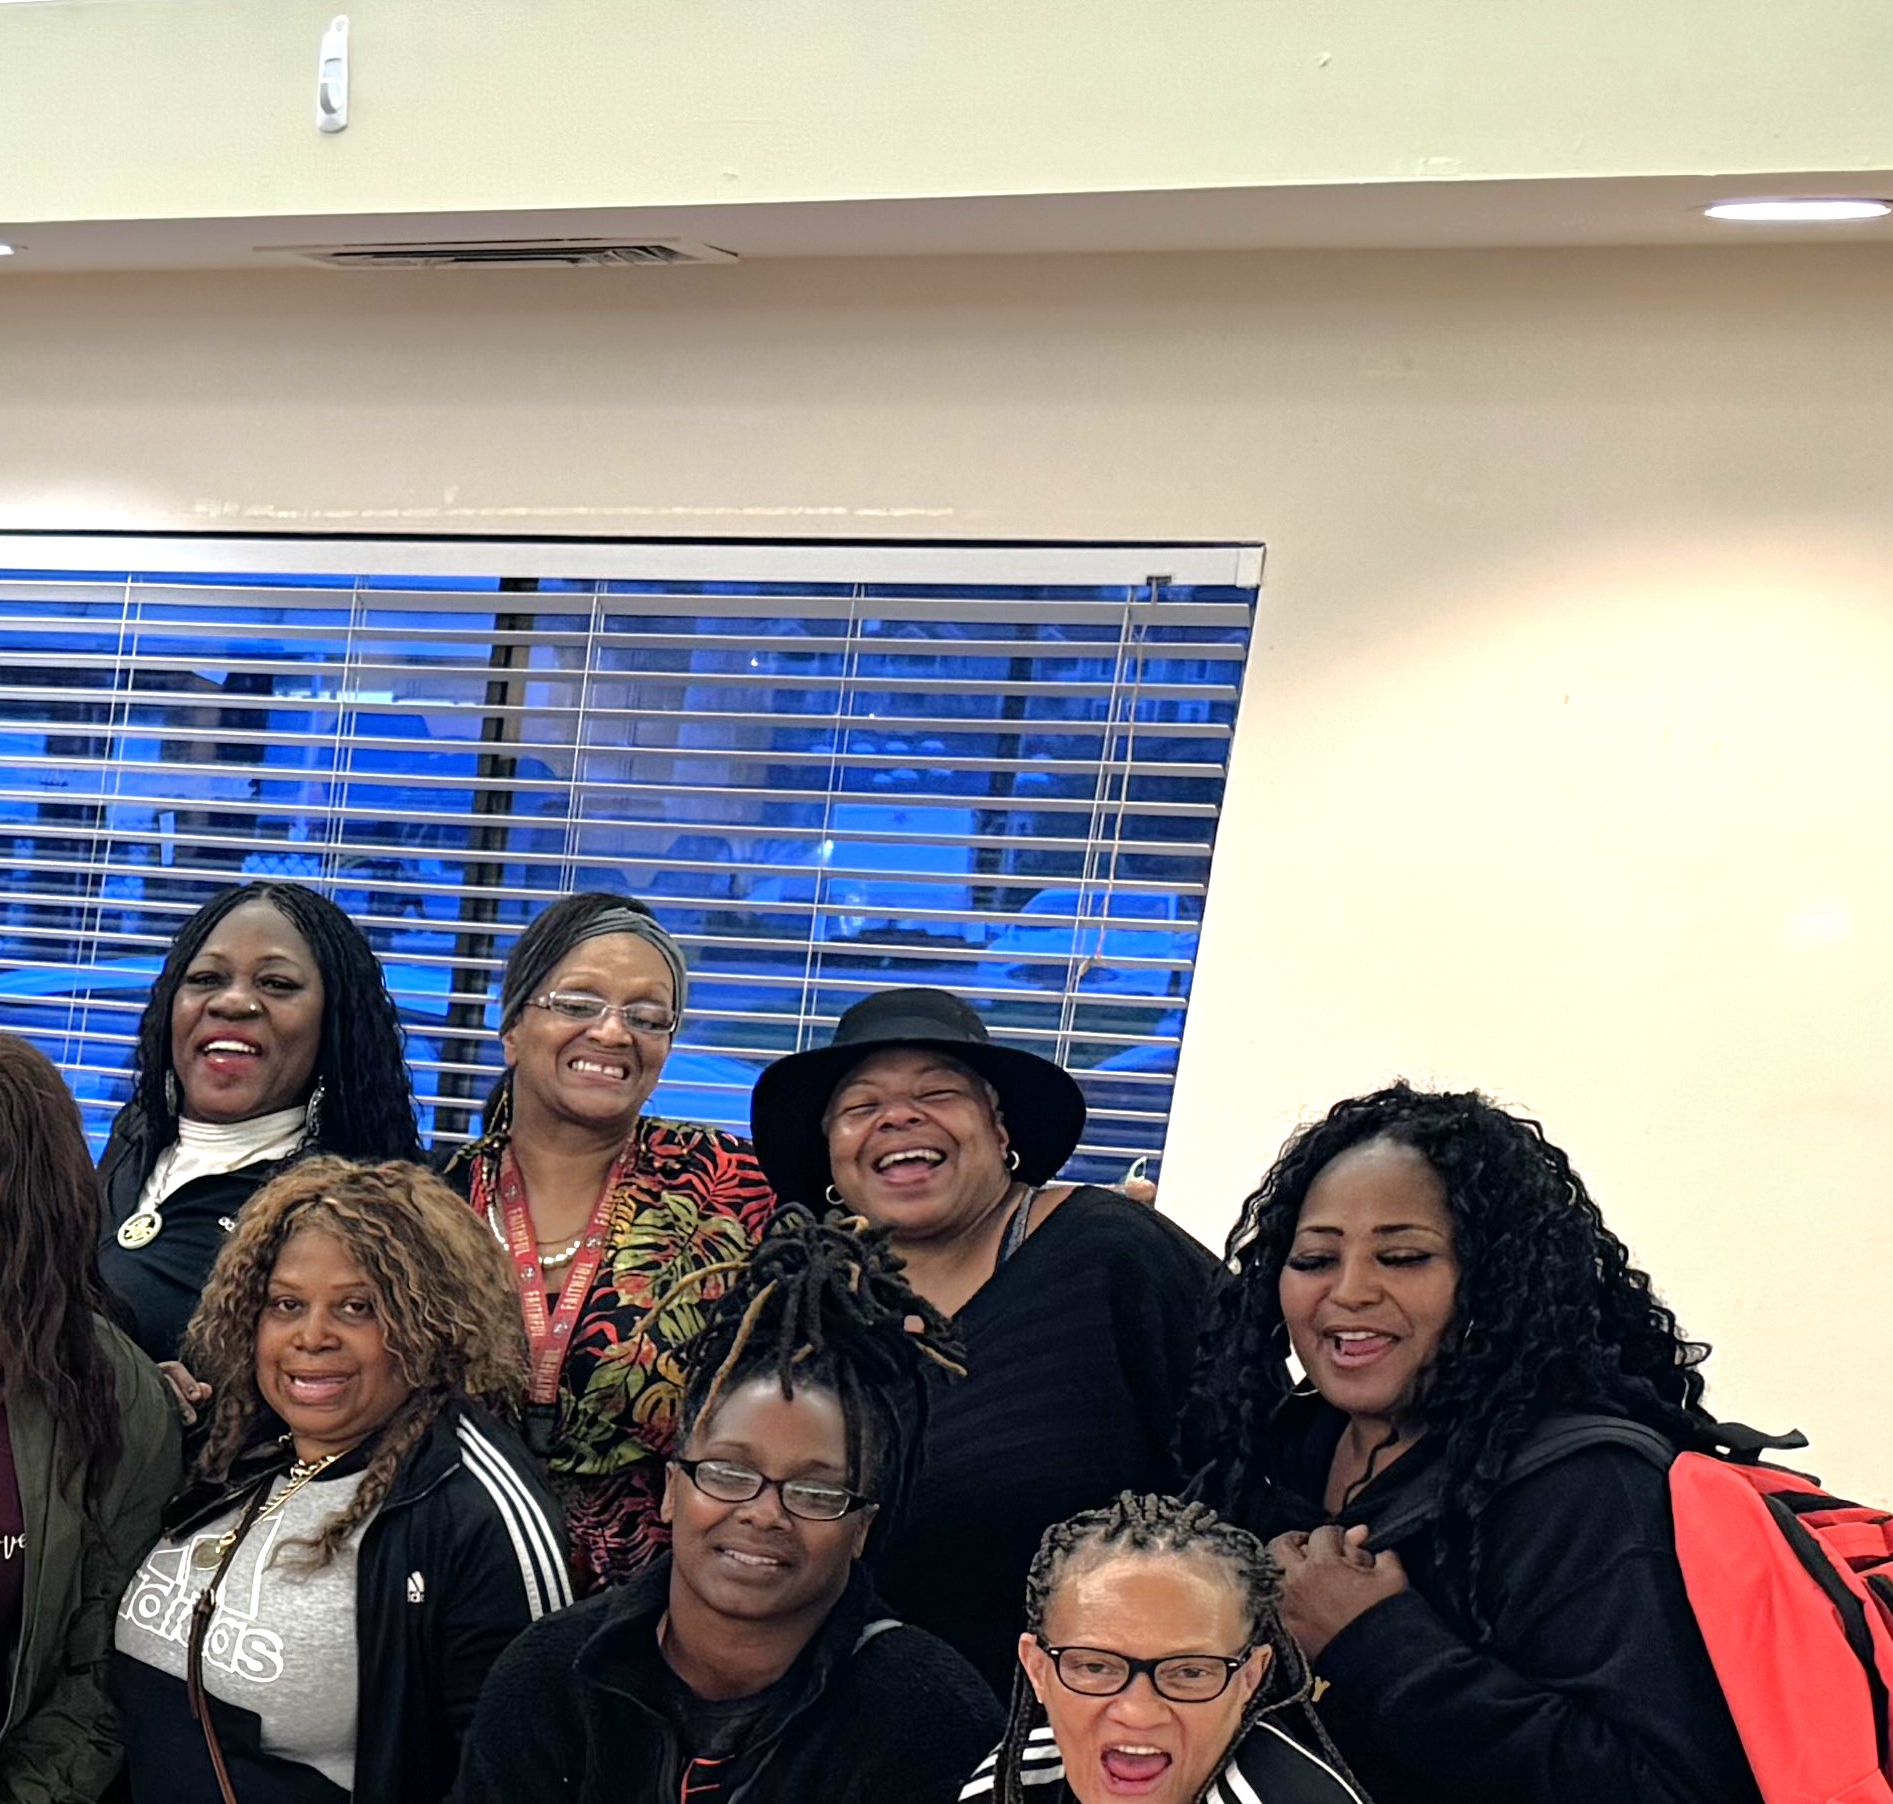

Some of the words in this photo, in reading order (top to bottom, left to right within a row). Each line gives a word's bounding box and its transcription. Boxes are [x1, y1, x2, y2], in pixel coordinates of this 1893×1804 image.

[507, 1207, 531, 1256] FAITHFUL
[559, 1262, 594, 1311] FAITHFUL
[524, 1290, 547, 1337] FAITHFUL
